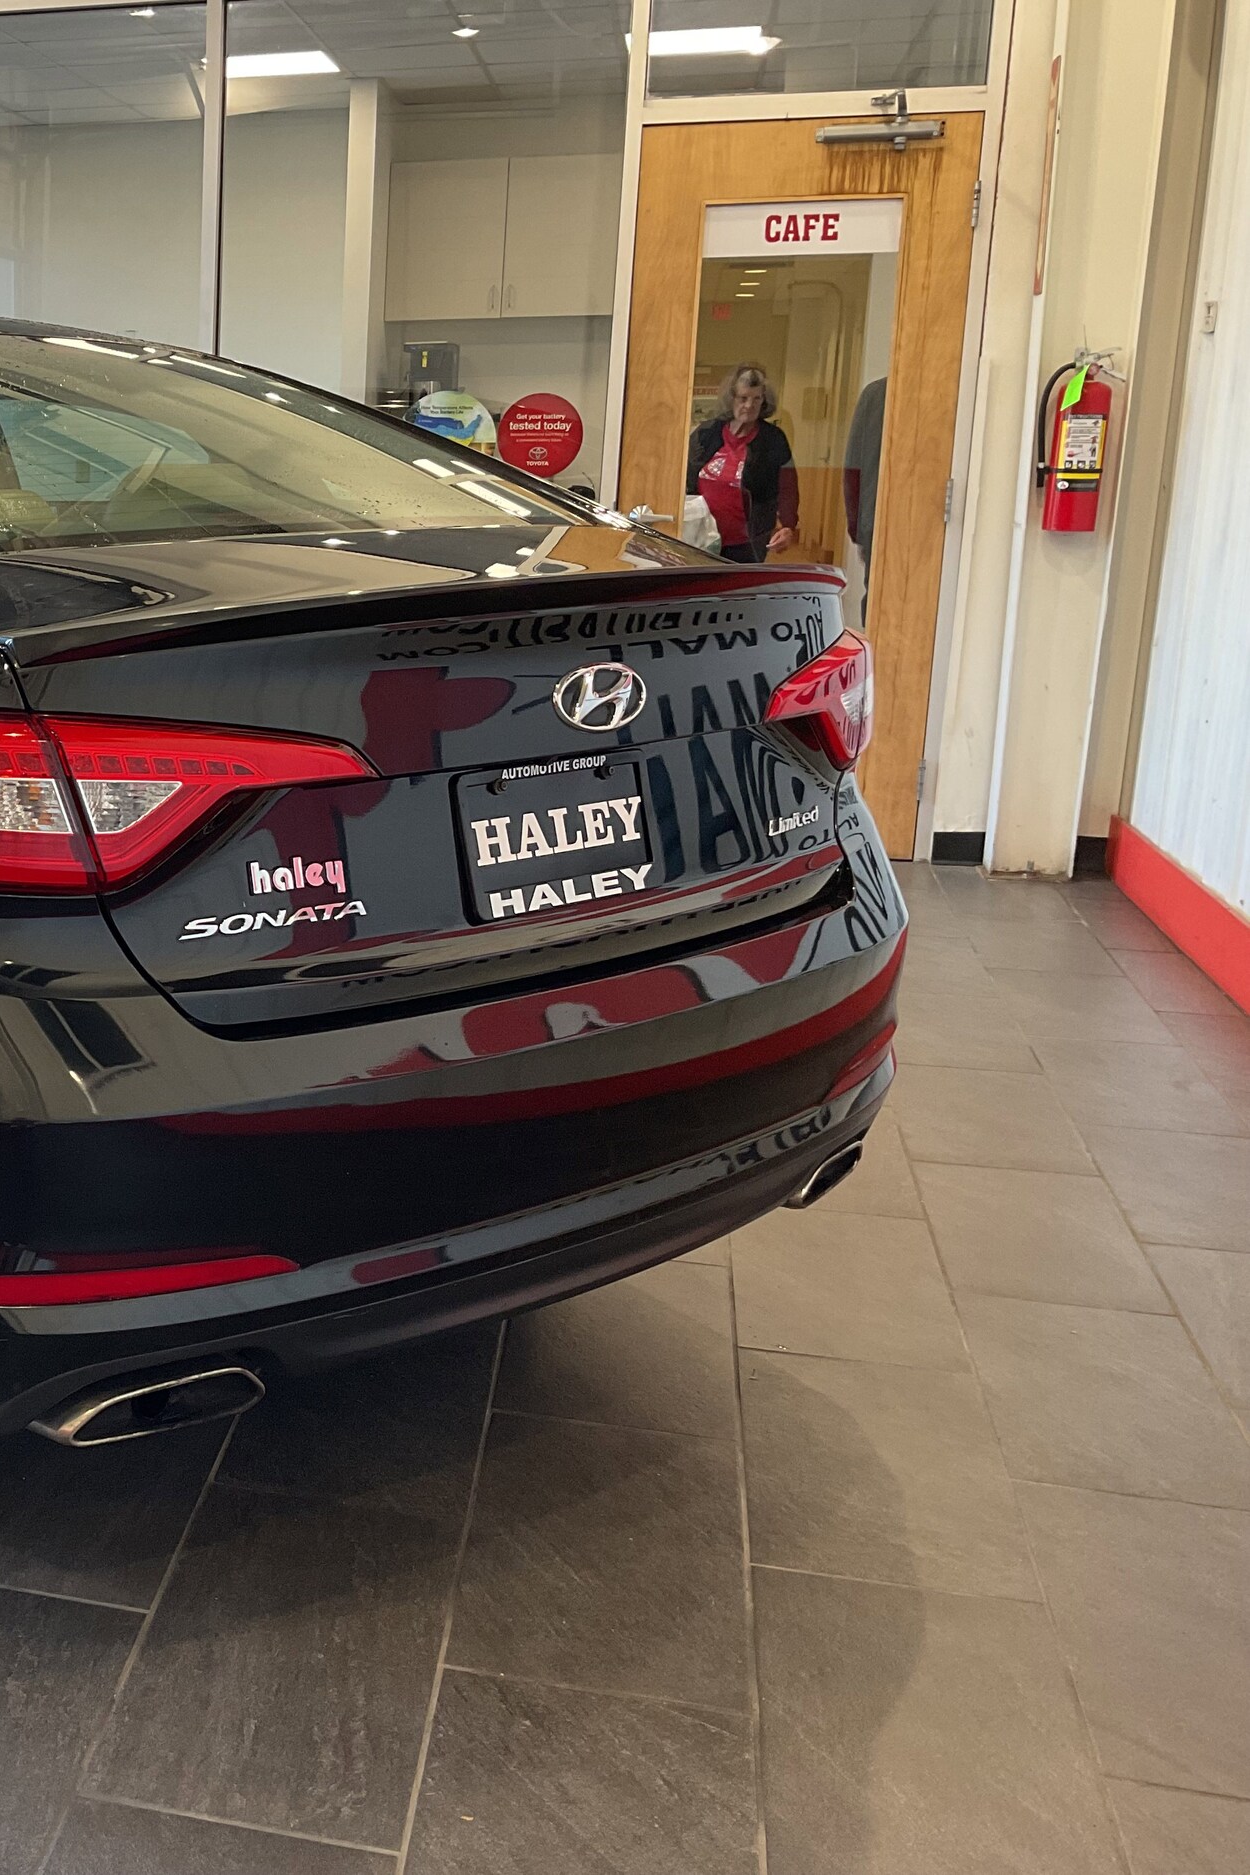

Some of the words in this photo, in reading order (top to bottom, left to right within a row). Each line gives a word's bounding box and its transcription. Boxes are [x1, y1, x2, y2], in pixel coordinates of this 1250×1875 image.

[764, 213, 840, 243] CAFE
[509, 421, 541, 431] tested
[543, 421, 572, 432] today
[543, 413, 566, 421] battery
[501, 759, 570, 780] AUTOMOTIVE
[572, 755, 607, 770] GROUP
[471, 796, 642, 867] HALEY
[768, 805, 819, 837] Limited
[249, 856, 346, 895] haley
[489, 863, 653, 919] HALEY
[178, 900, 368, 941] SONATA
